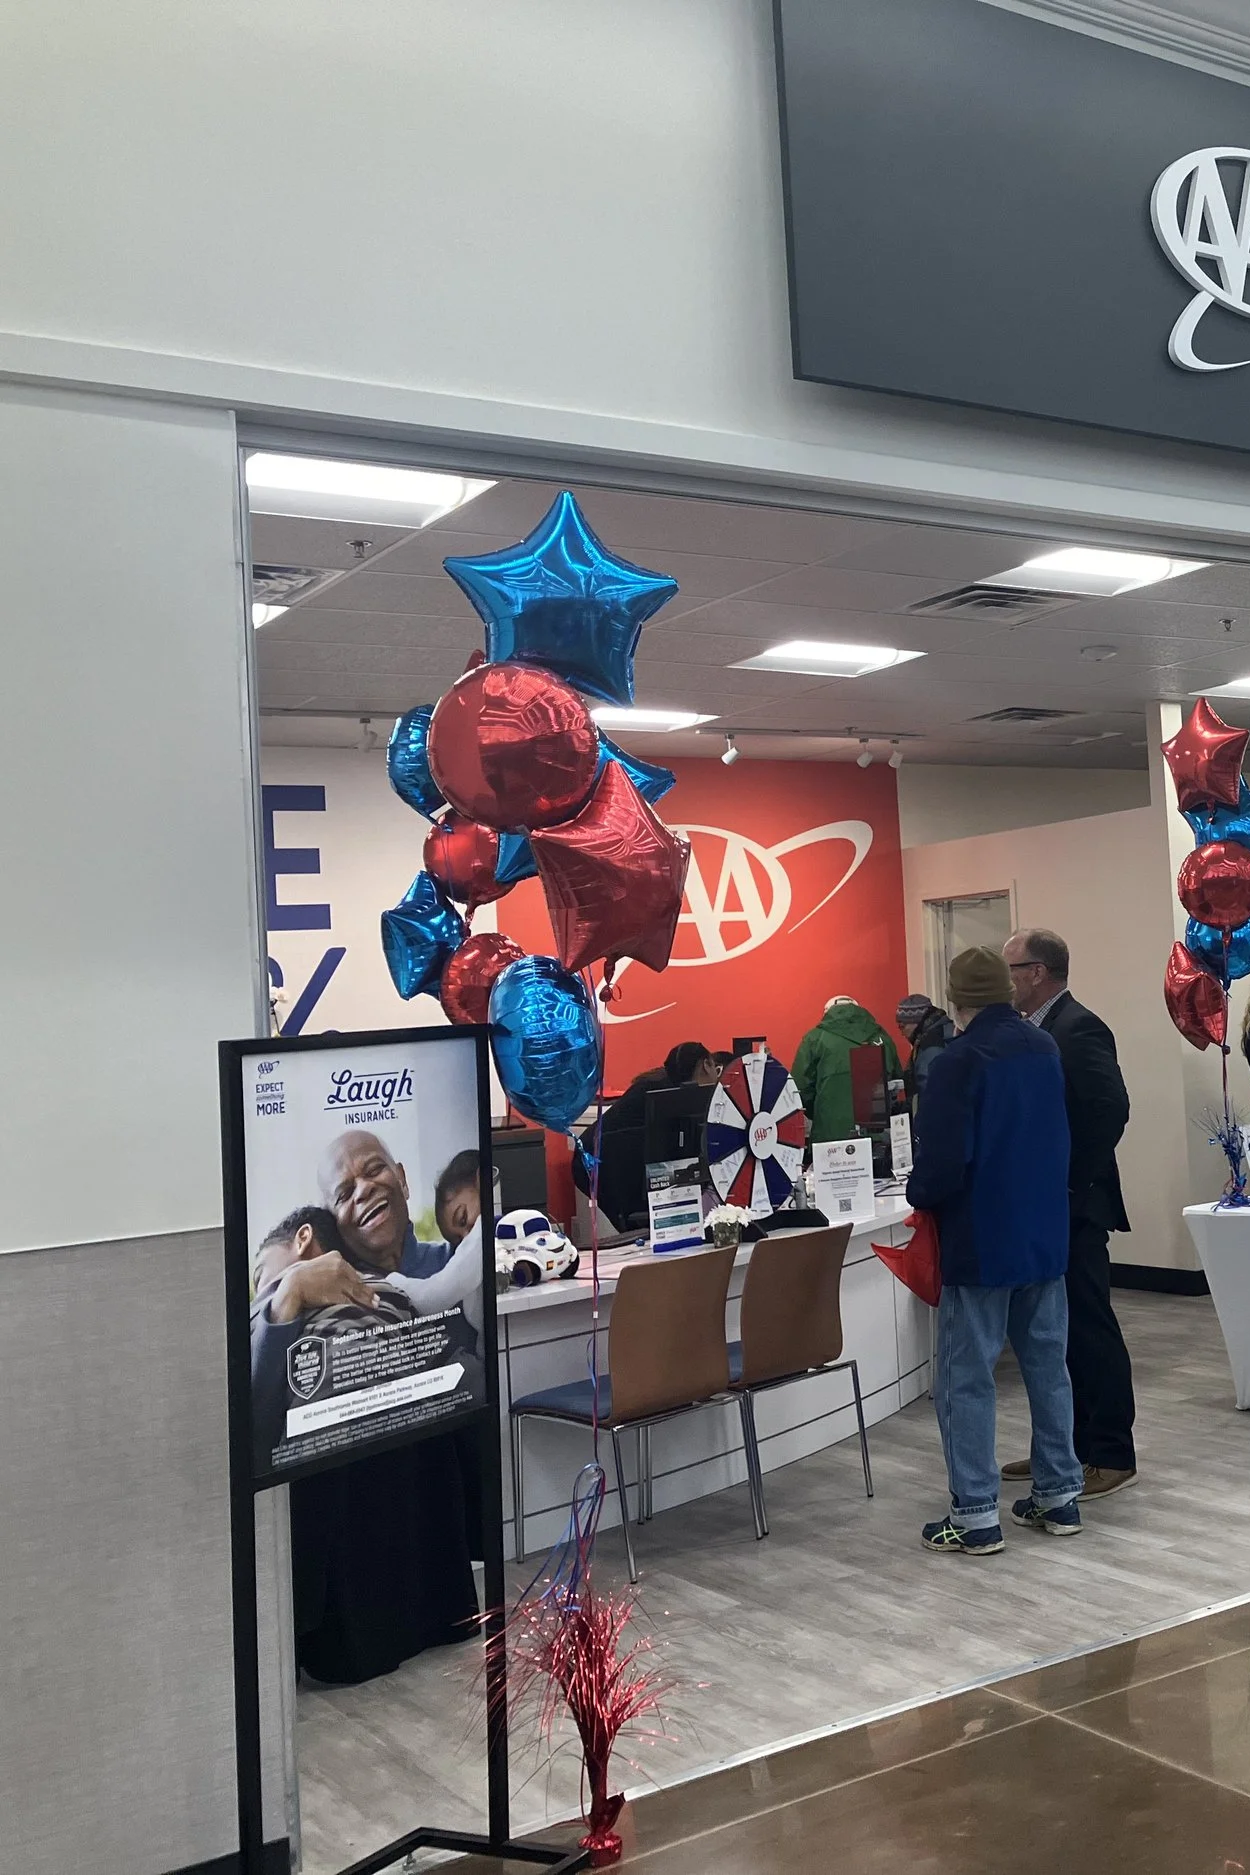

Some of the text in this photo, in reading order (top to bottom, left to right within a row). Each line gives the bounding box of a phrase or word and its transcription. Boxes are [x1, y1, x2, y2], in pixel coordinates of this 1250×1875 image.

[255, 1082, 284, 1093] EXPECT
[327, 1068, 413, 1107] Laugh
[256, 1101, 286, 1116] MORE
[332, 1331, 365, 1345] September
[372, 1325, 384, 1336] Life
[384, 1319, 413, 1333] Insurance
[413, 1311, 444, 1325] Awareness
[444, 1306, 461, 1318] Month
